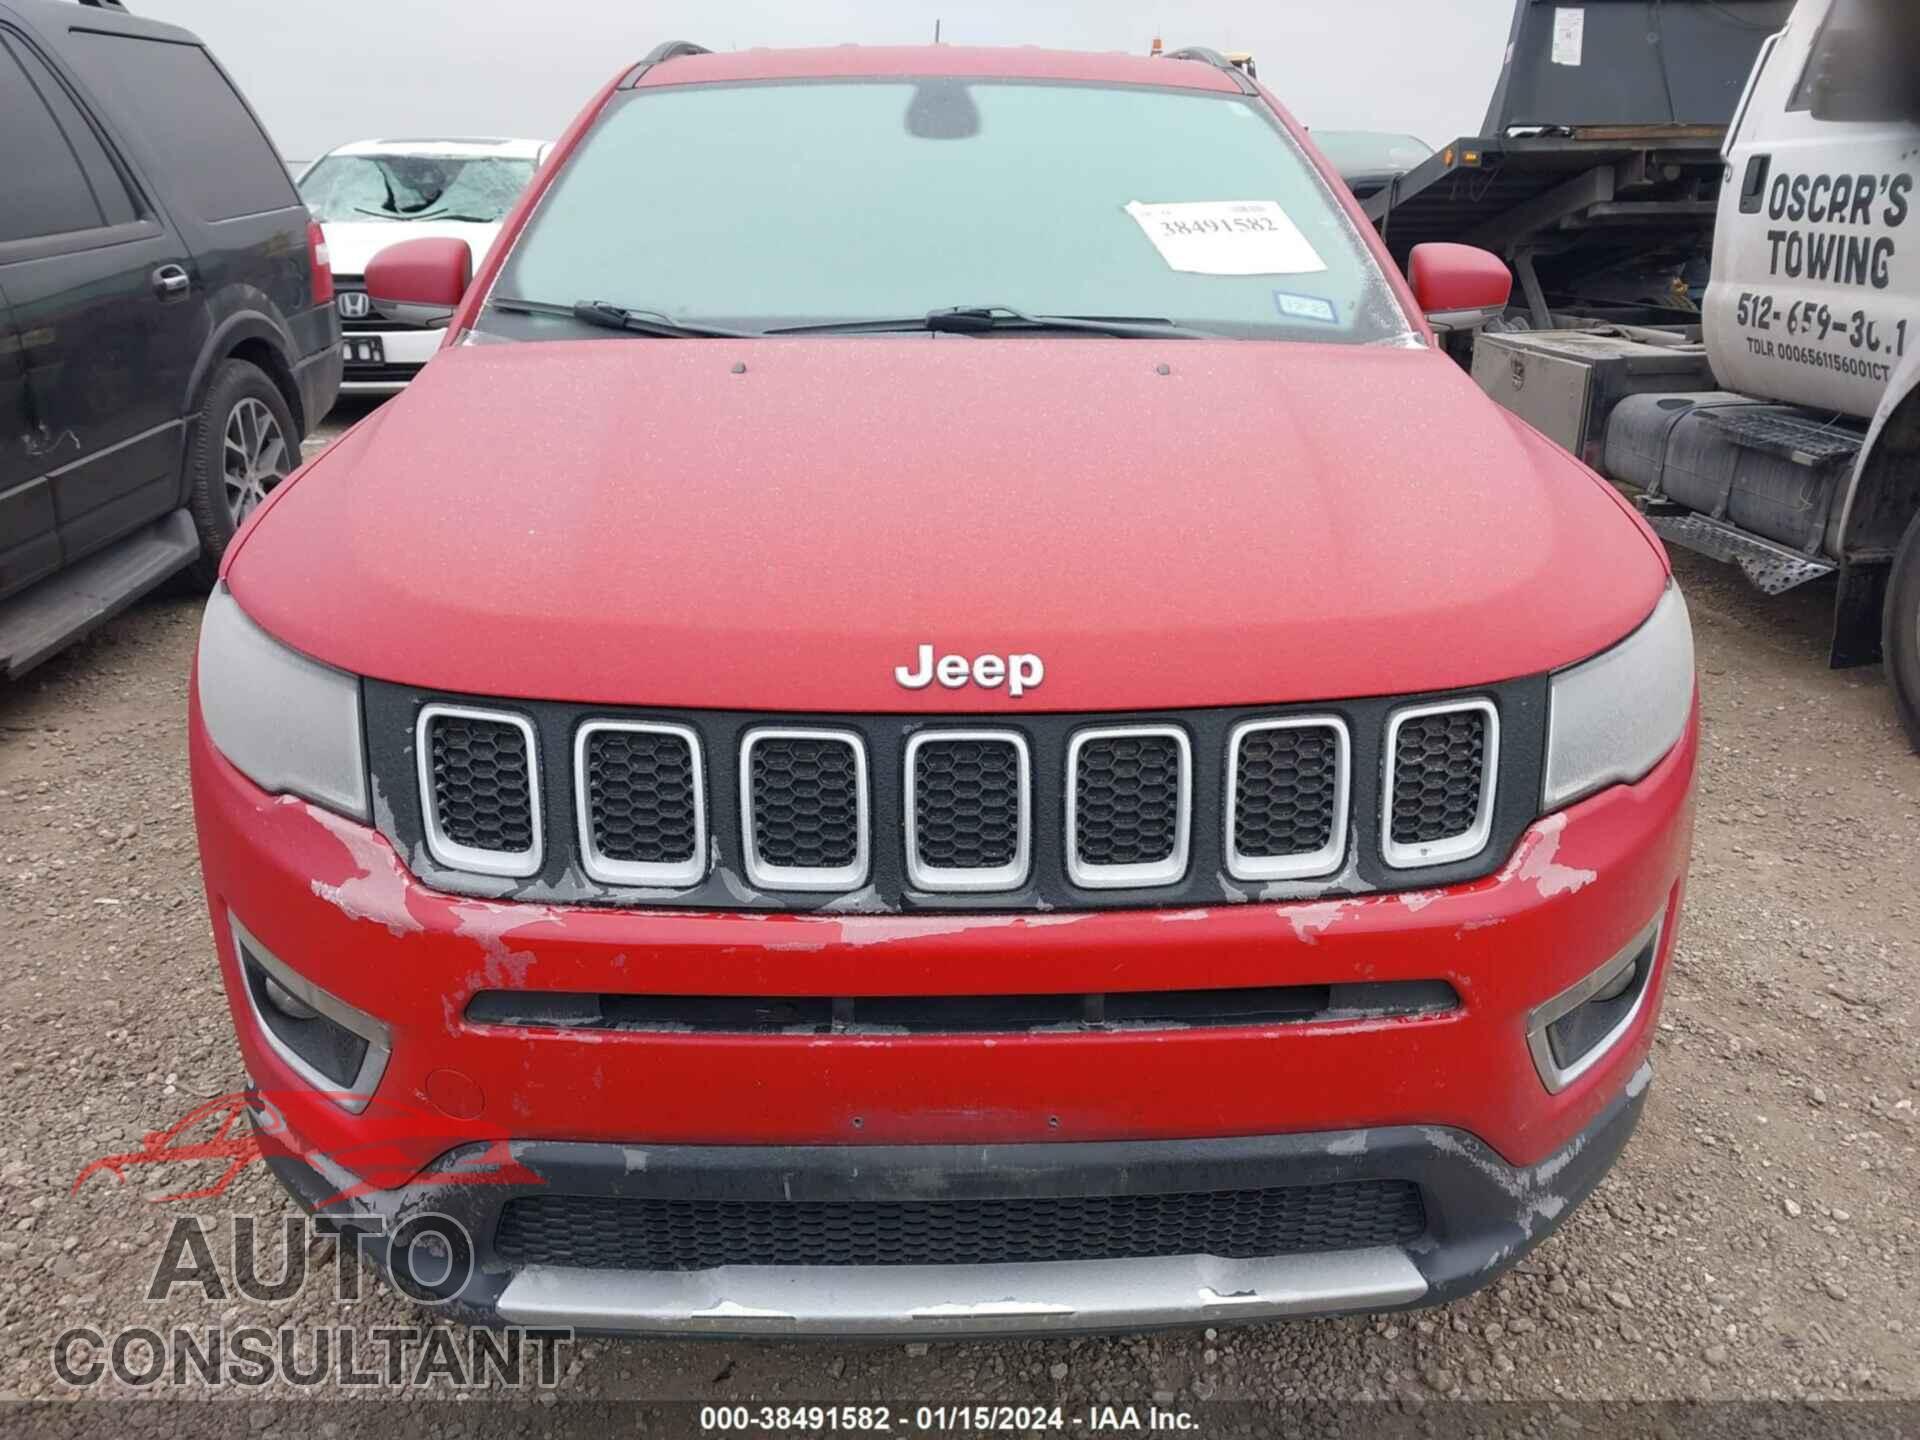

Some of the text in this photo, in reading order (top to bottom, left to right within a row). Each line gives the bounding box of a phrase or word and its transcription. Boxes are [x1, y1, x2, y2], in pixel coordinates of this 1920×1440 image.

[1160, 217, 1279, 237] 38491582
[1768, 173, 1913, 228] OSCAR'S
[1767, 229, 1895, 290] TOWING
[1746, 337, 1775, 358] TDLR
[895, 643, 1044, 698] Jeep
